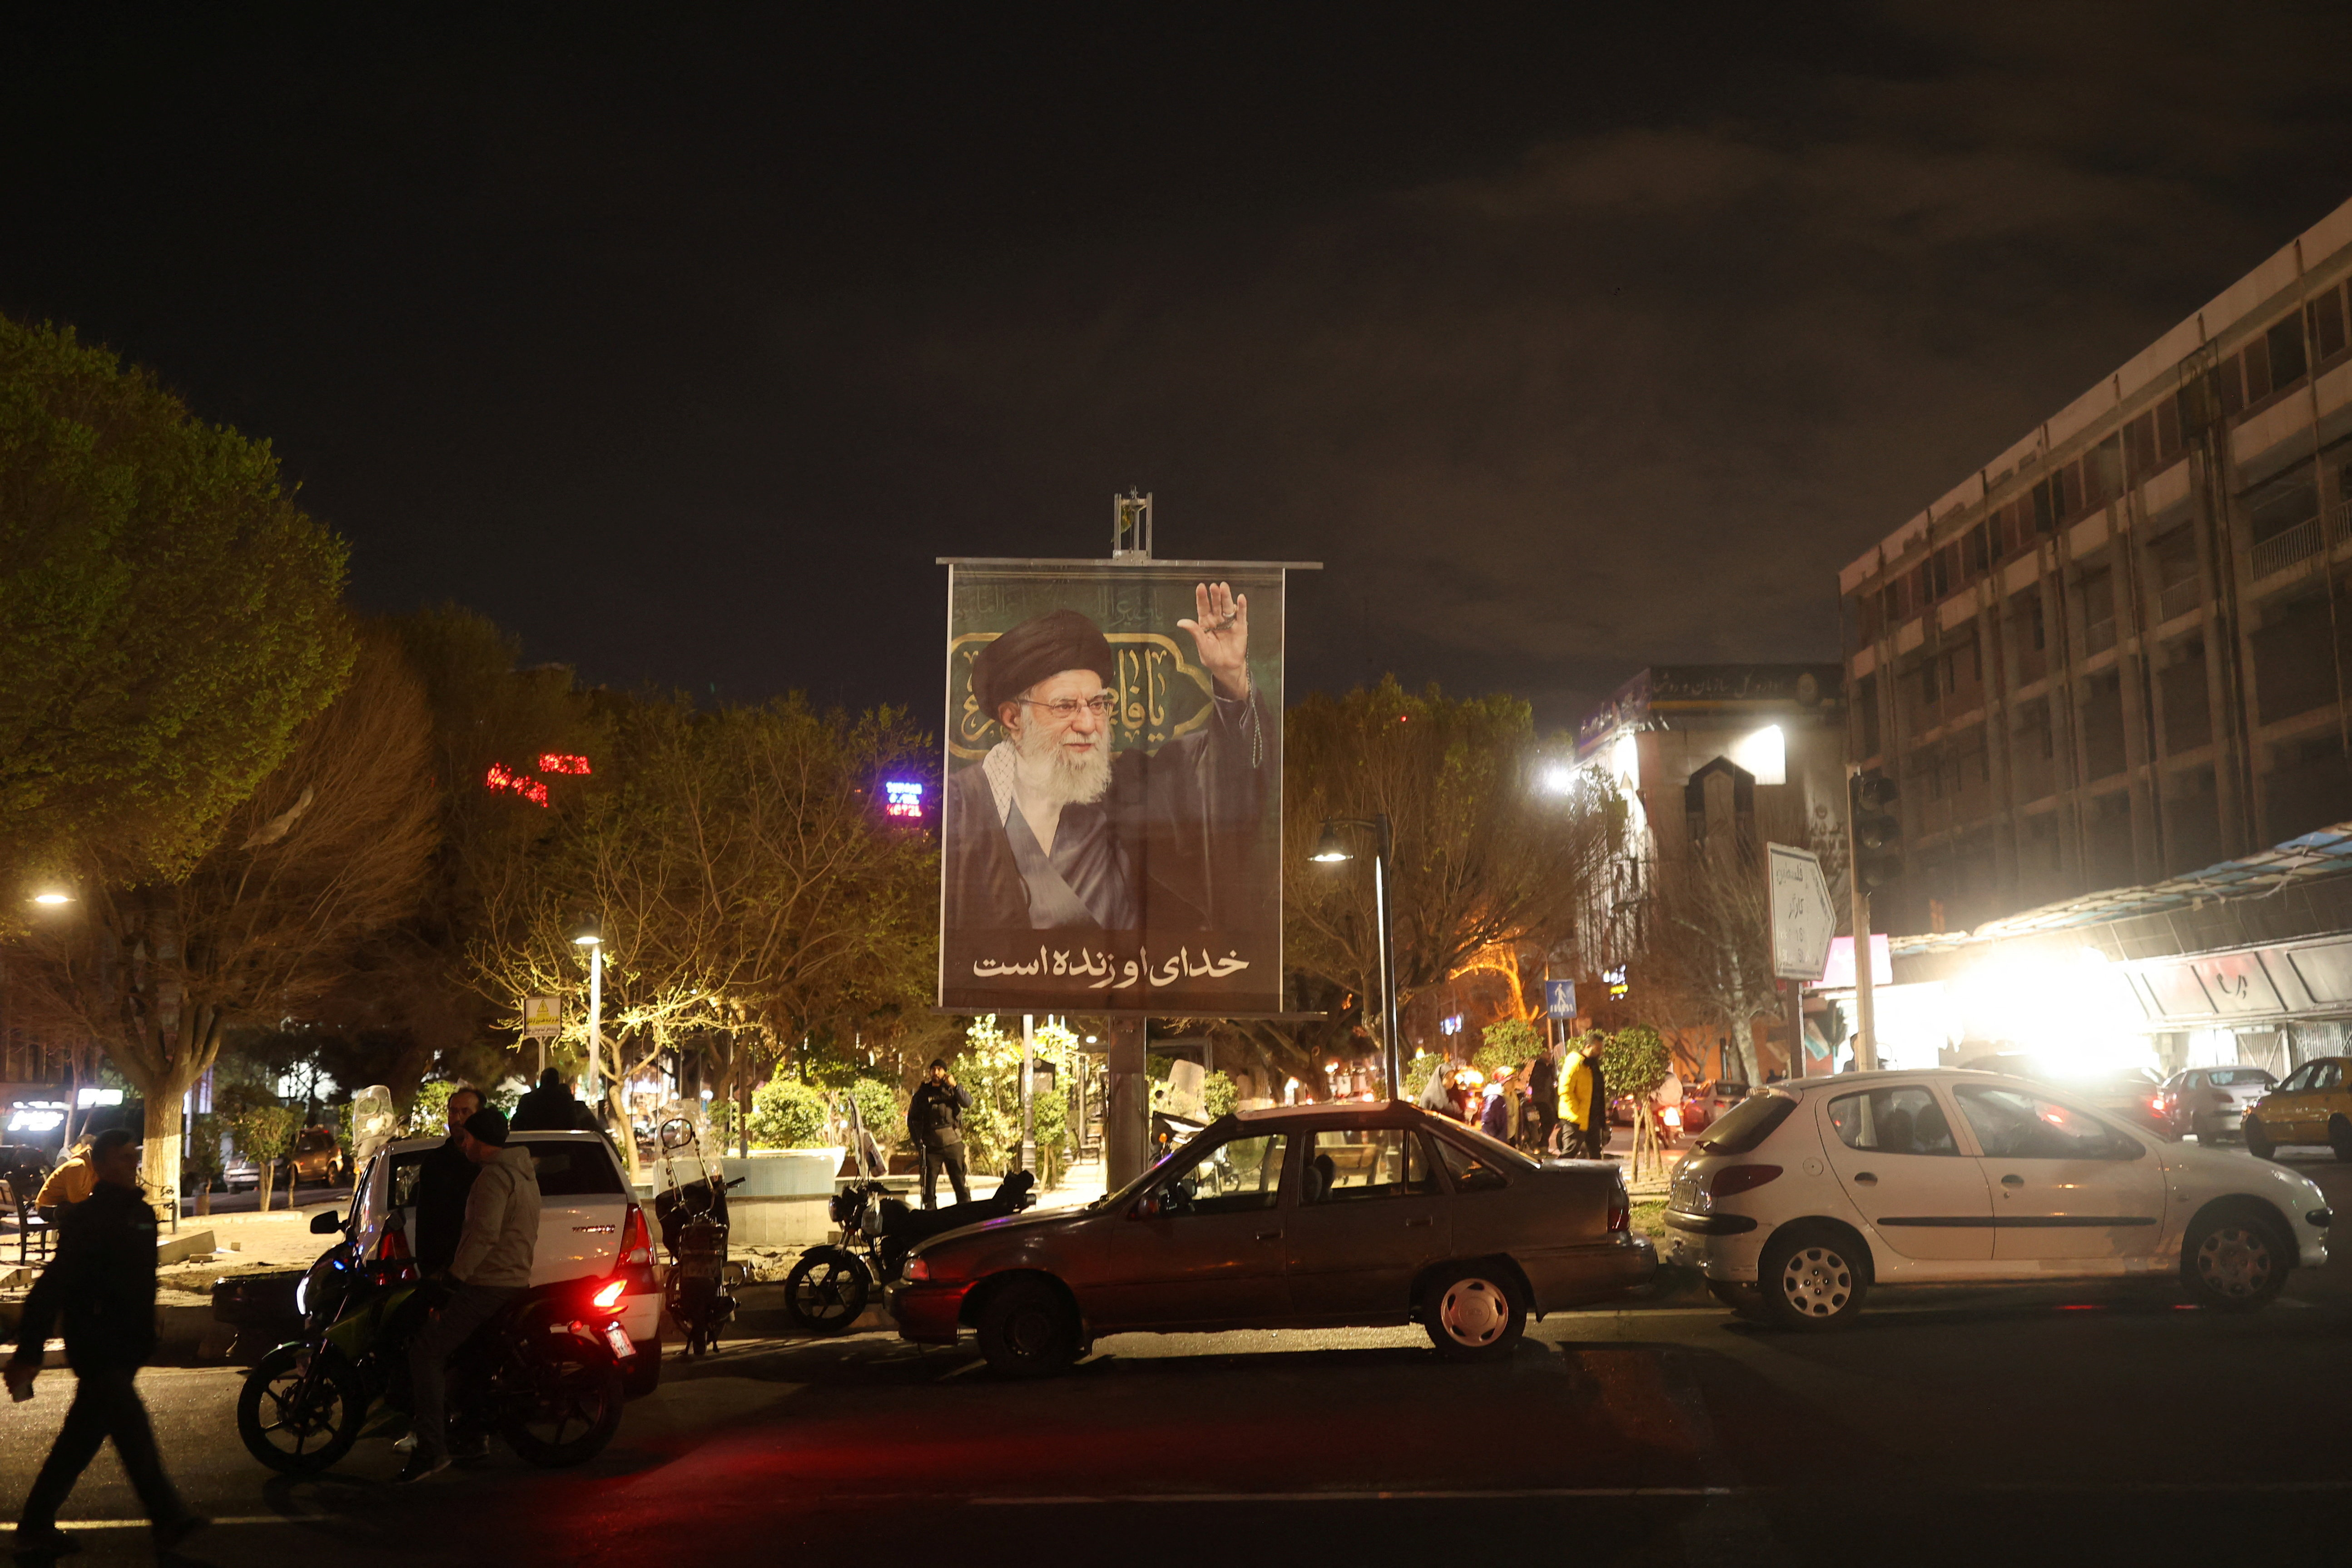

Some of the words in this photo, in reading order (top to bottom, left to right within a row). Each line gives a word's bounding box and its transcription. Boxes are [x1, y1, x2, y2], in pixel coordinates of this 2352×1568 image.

[1776, 862, 1803, 885] فلسطین
[1788, 893, 1804, 919] کارگر
[973, 944, 1048, 978] است
[1053, 946, 1116, 989] زنده
[1112, 945, 1148, 989] او
[1149, 945, 1250, 987] خدای
